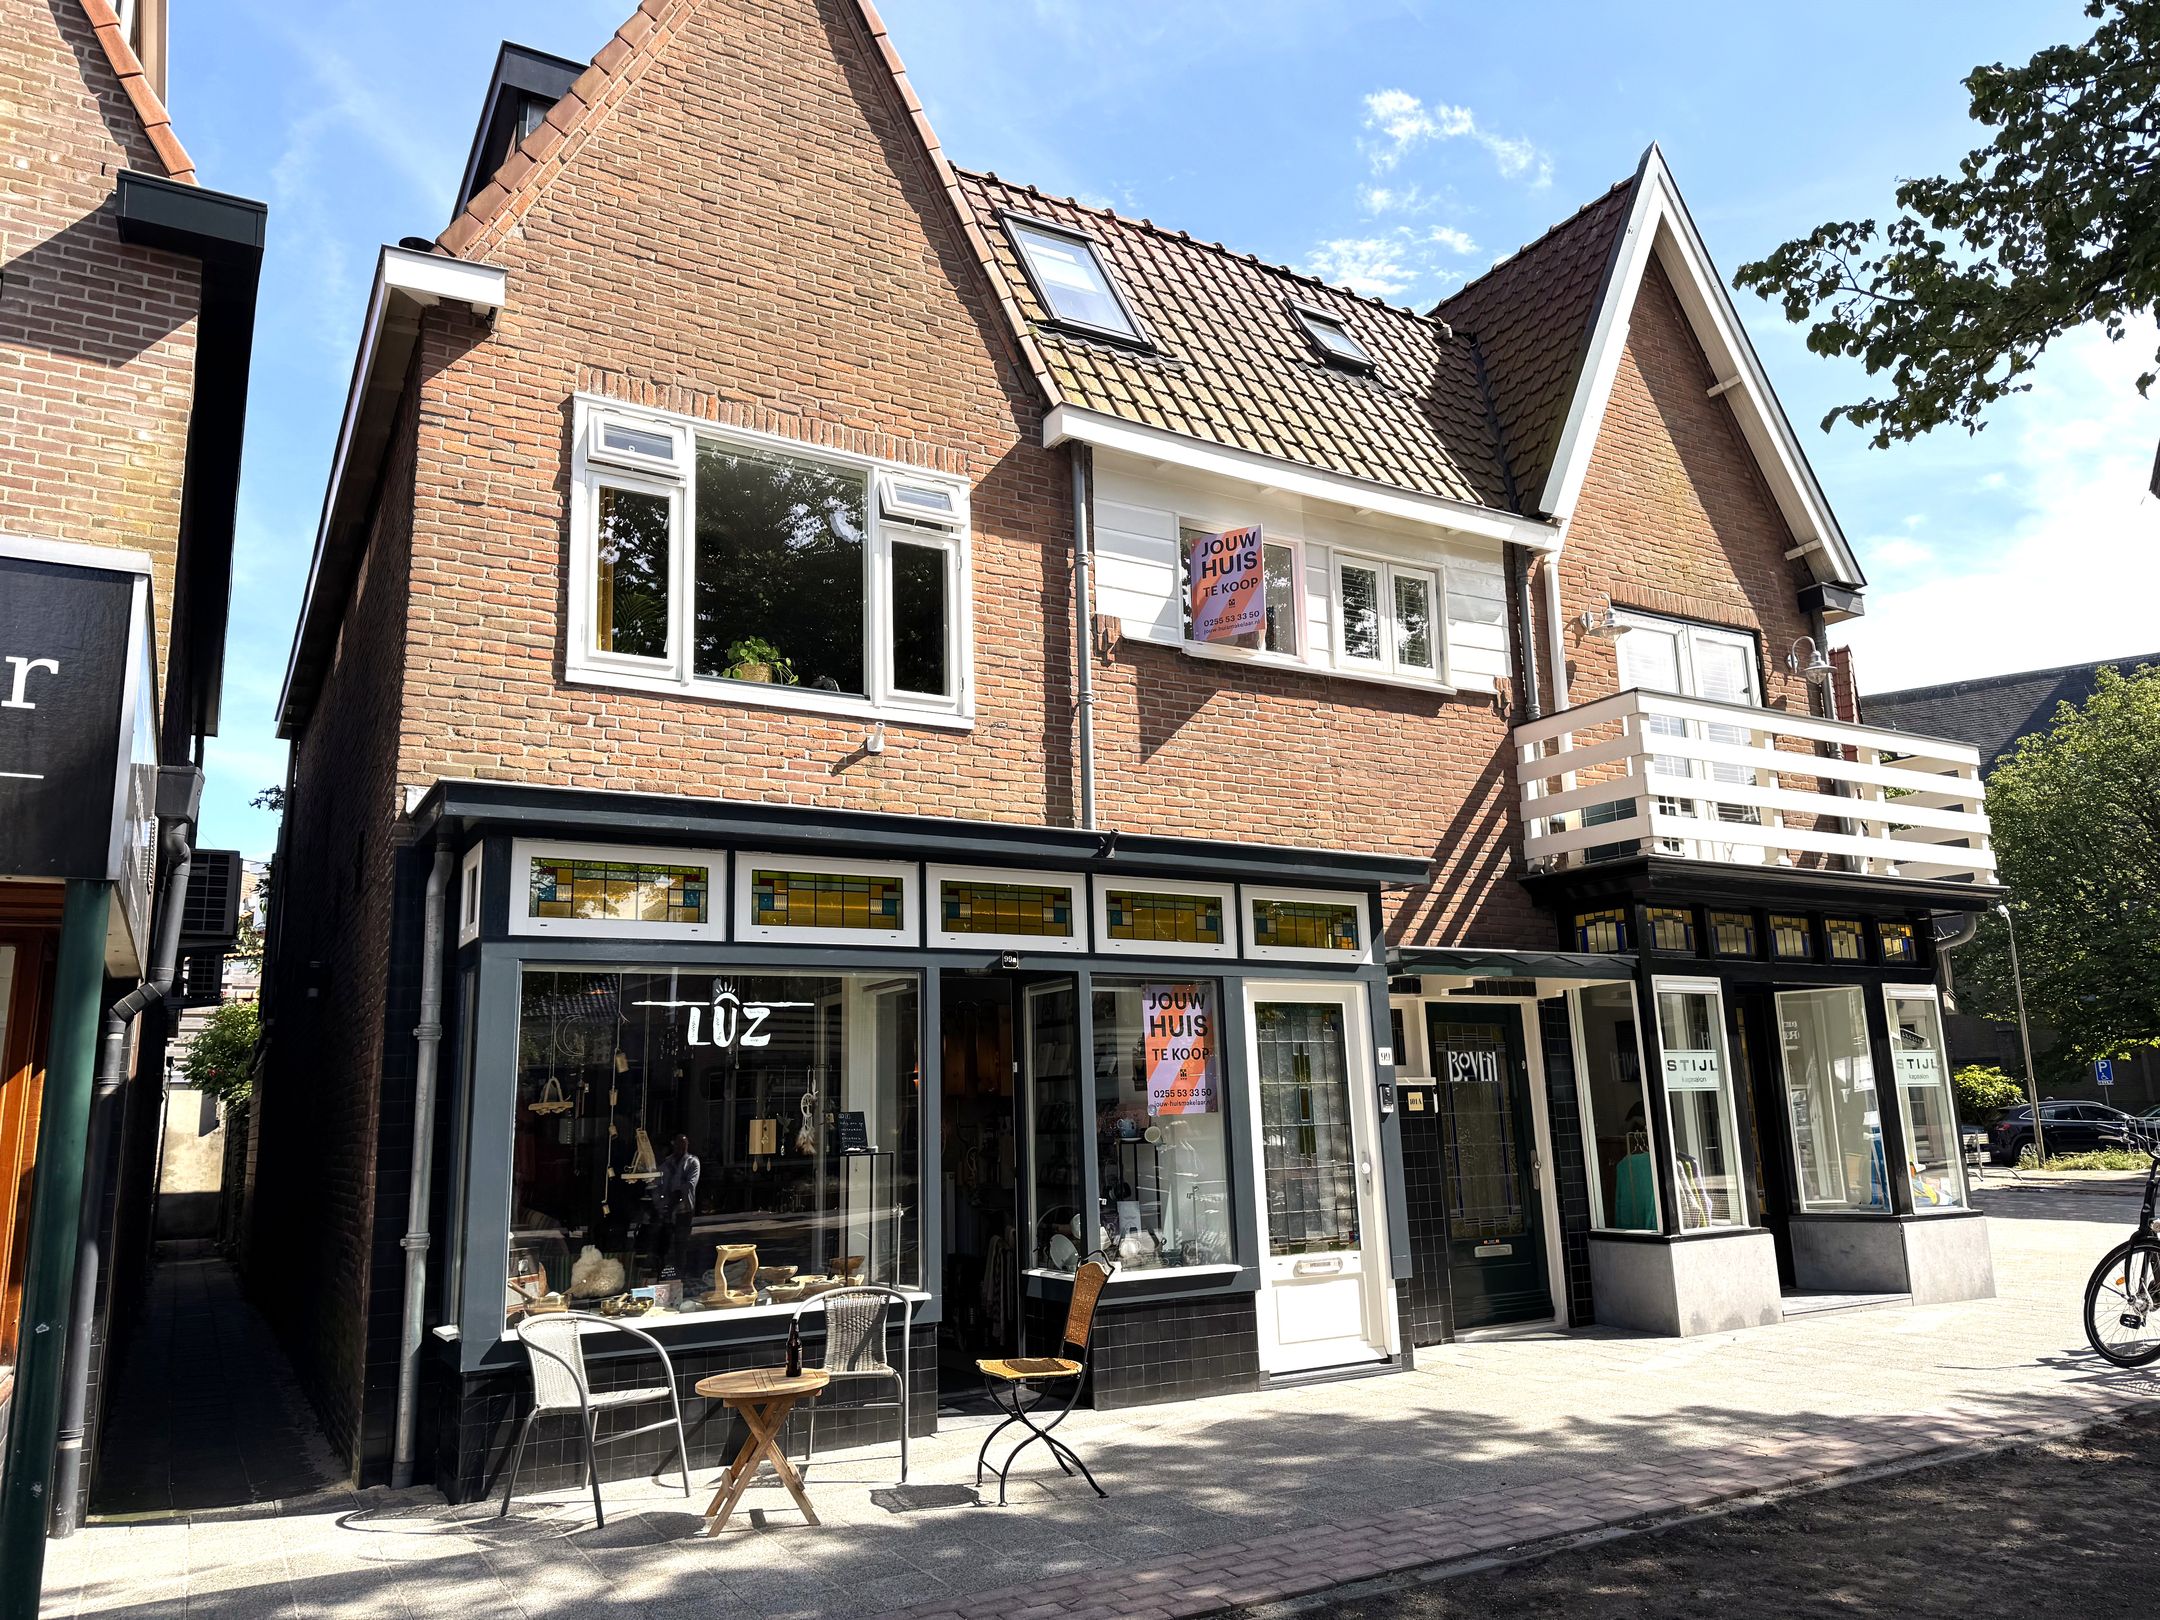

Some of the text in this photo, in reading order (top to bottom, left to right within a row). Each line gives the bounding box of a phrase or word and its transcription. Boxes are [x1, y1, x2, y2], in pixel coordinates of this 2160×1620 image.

[1201, 532, 1256, 557] JOUW
[1201, 551, 1257, 579] HUIS
[1203, 577, 1259, 597] TE KOOP
[1203, 610, 1260, 627] 0255 53 33 50
[1149, 992, 1205, 1010] JOUW
[1149, 1015, 1208, 1037] HUIS
[1152, 1047, 1209, 1061] TE KOOP
[1447, 1051, 1498, 1082] BOVEN
[1666, 1059, 1718, 1071] STIJL
[1896, 1058, 1940, 1069] STIJL
[2098, 1061, 2108, 1073] P
[1153, 1088, 1212, 1098] 0255 53 33 50
